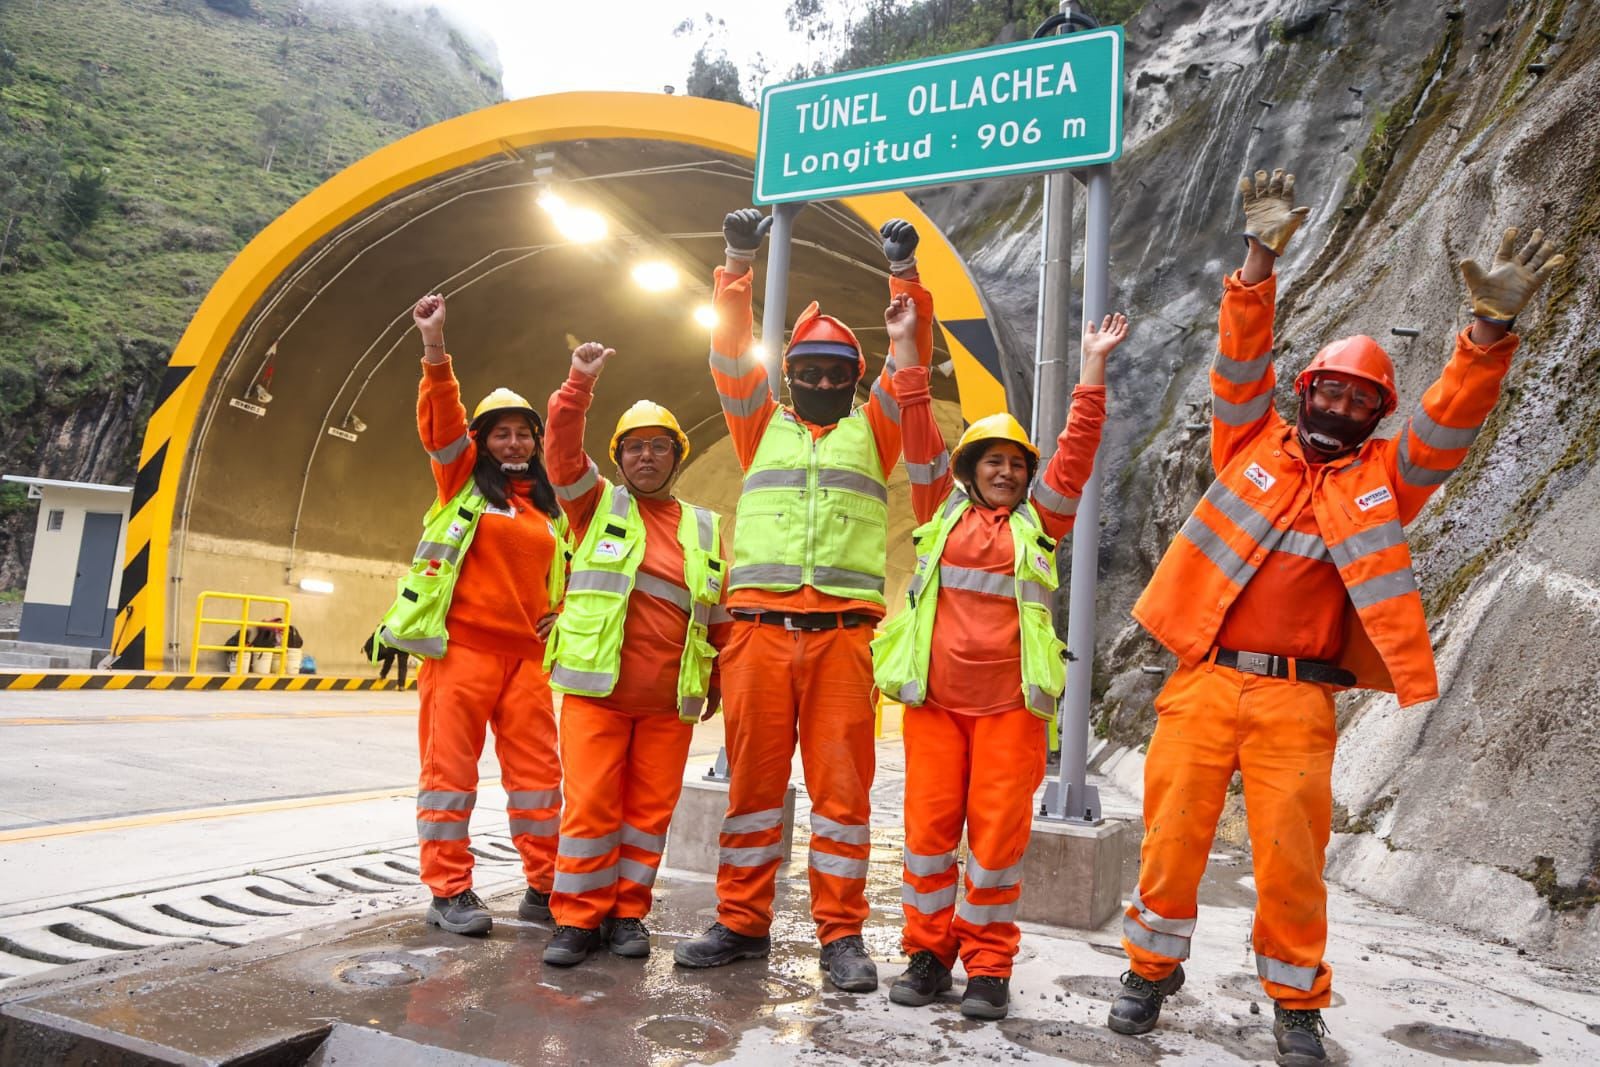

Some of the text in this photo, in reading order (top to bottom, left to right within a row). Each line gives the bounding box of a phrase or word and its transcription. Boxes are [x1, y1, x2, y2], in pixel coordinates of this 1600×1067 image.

[796, 62, 1078, 134] TÚNEL OLLACHEA
[783, 133, 932, 177] Longitud
[977, 118, 1042, 149] 906
[1063, 117, 1087, 139] m
